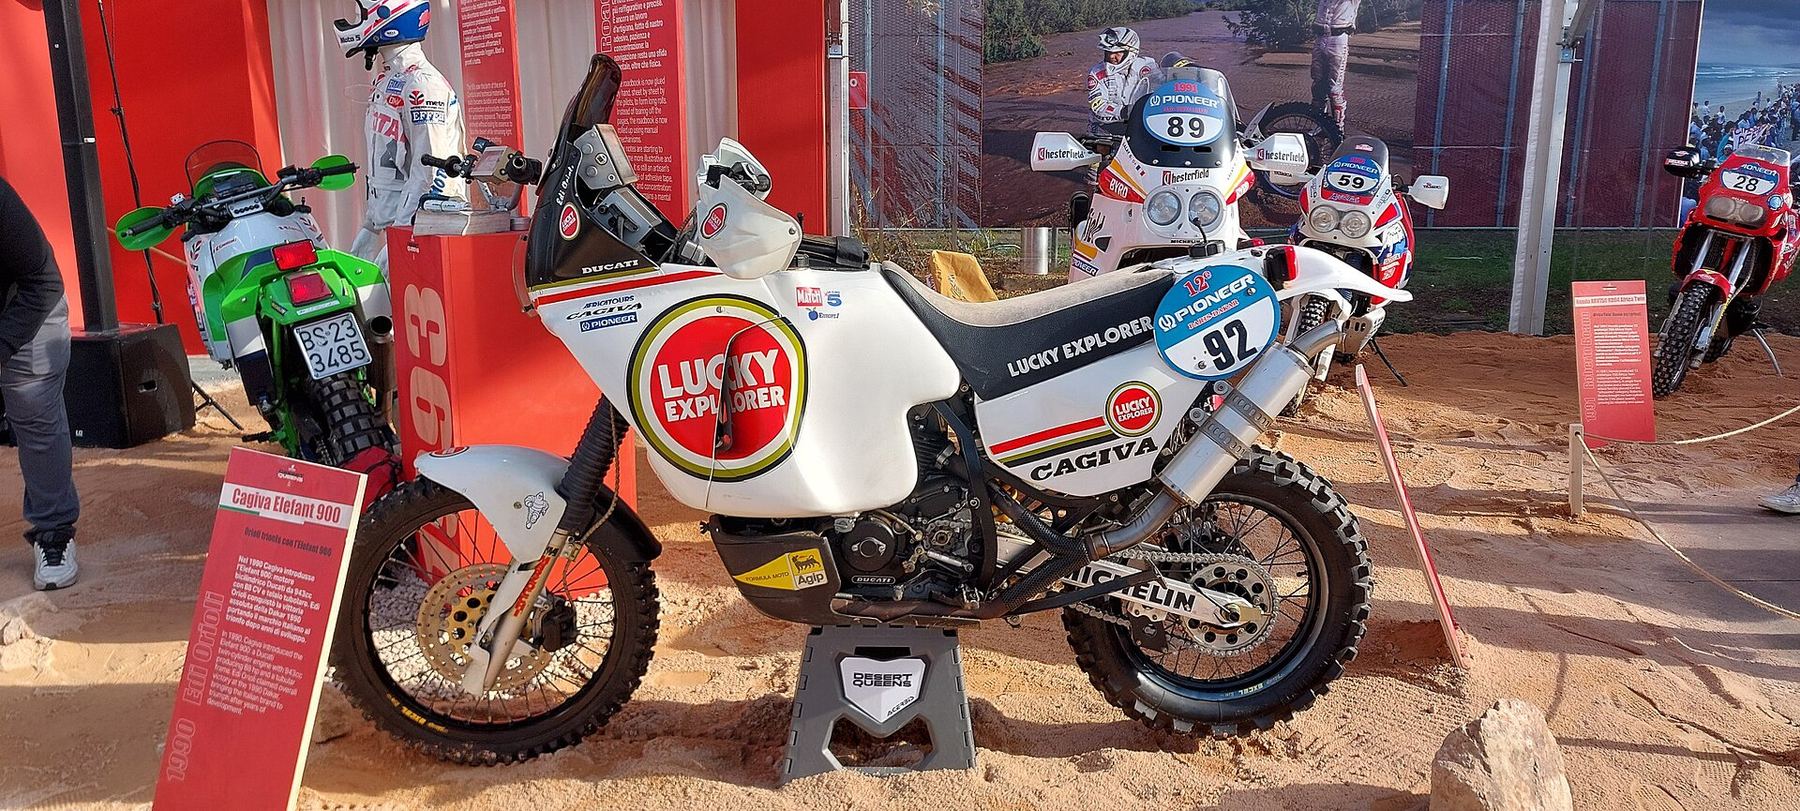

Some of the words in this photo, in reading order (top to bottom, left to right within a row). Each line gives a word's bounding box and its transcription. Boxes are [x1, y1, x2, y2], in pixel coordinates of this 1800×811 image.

[1162, 94, 1218, 108] PIONEER
[1167, 116, 1205, 138] 89
[1257, 148, 1305, 162] Chesterfield
[1162, 169, 1210, 186] Chesterfield
[1338, 174, 1365, 189] 59
[1733, 175, 1759, 192] 28
[1109, 179, 1130, 199] BYRD
[581, 259, 639, 275] DUCATI
[1175, 273, 1256, 323] PIONEER
[566, 303, 642, 320] CAGIVA
[591, 314, 636, 329] PIONEER
[299, 326, 329, 351] BS
[328, 318, 357, 343] 23
[1006, 347, 1060, 377] LUCKY
[1062, 315, 1154, 359] EXPLORER
[1202, 319, 1258, 371] 92
[309, 340, 366, 373] 3485
[658, 348, 779, 399] LUCKY
[664, 385, 786, 423] EXPLORER
[1115, 396, 1151, 416] LUCKY
[1118, 407, 1154, 423] EXPLORER
[1030, 436, 1159, 482] CAGIVA
[232, 487, 270, 511] Cagiva
[272, 495, 315, 519] Elefant
[316, 503, 341, 524] 900
[797, 573, 824, 587] Agip
[192, 590, 225, 663] Orioli
[852, 680, 912, 688] QUEENS
[853, 673, 913, 681] DESERT
[166, 717, 196, 783] 1990
